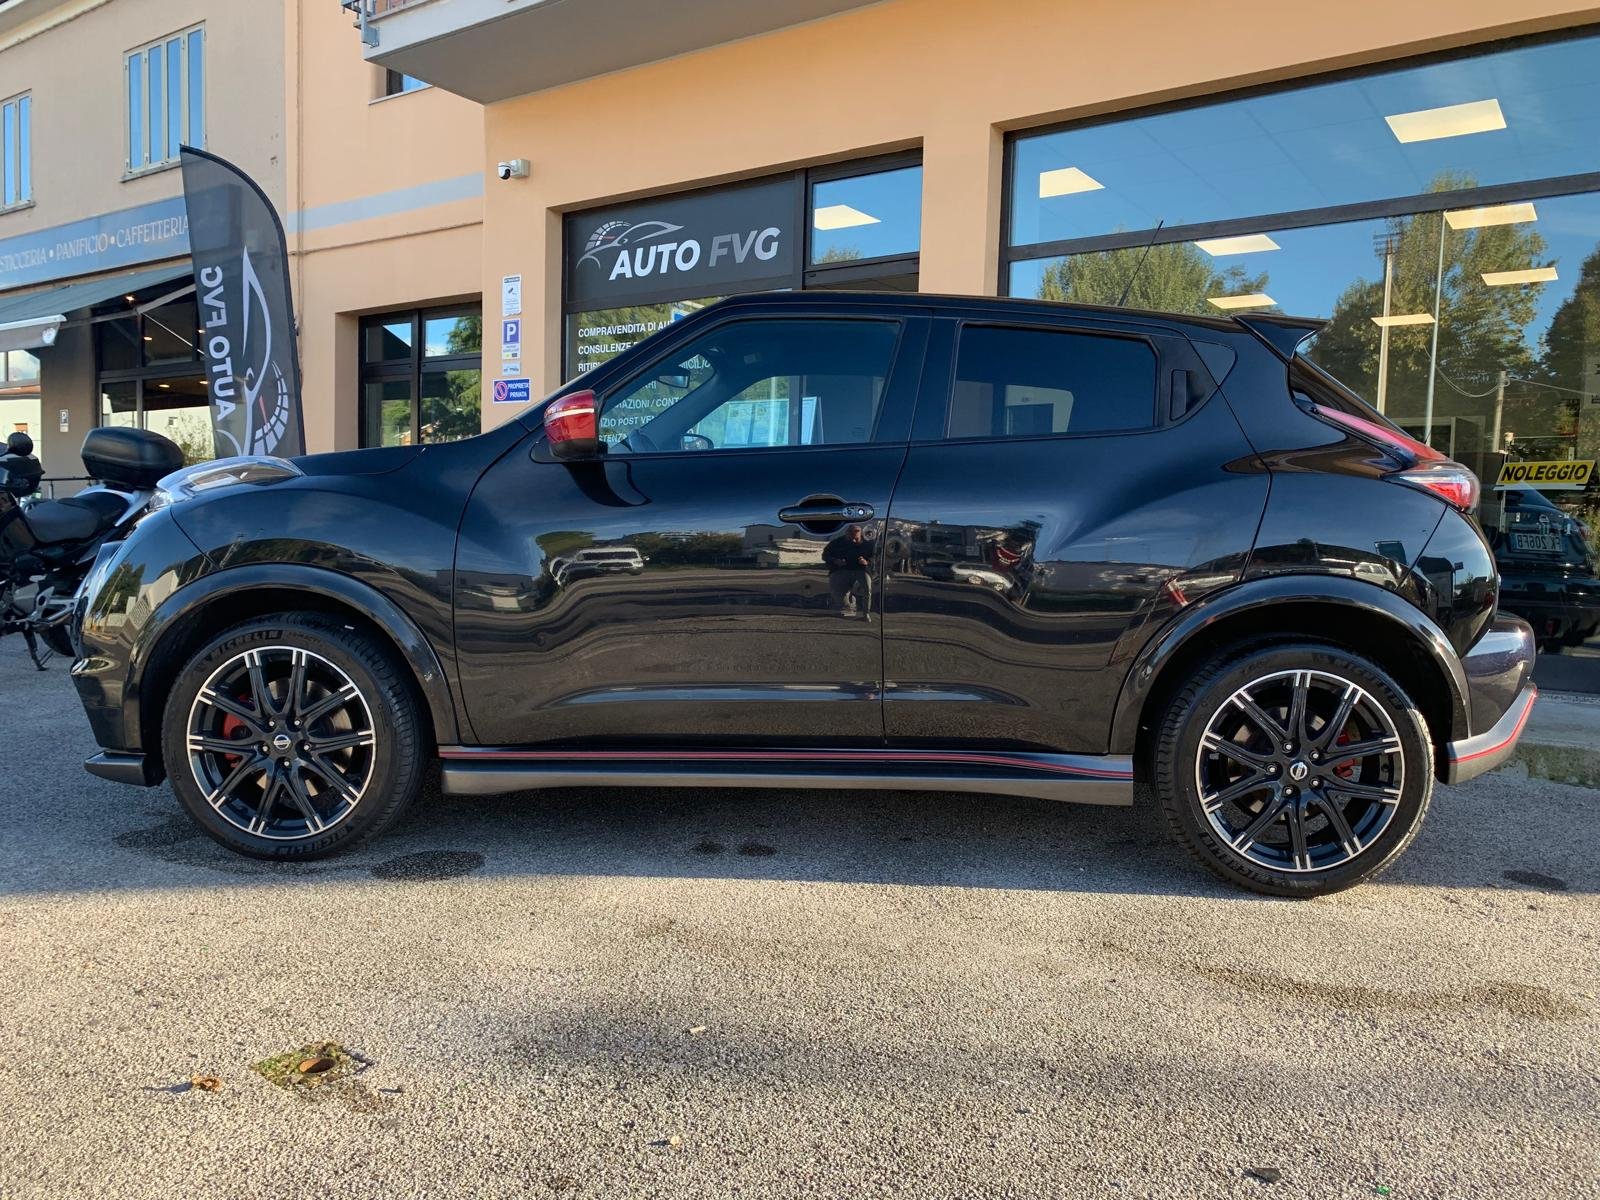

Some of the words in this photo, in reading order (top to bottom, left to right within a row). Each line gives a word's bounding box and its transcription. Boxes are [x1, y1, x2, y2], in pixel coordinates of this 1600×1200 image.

[56, 233, 109, 262] PANIFICIO
[609, 239, 701, 281] AUTO
[709, 227, 781, 268] FVG
[506, 323, 517, 342] P
[578, 323, 646, 338] COMPRAVENDITA
[648, 322, 657, 331] DI
[578, 342, 632, 355] CONSULENZE
[618, 416, 639, 427] POST
[1501, 464, 1588, 481] NOLEGGIO
